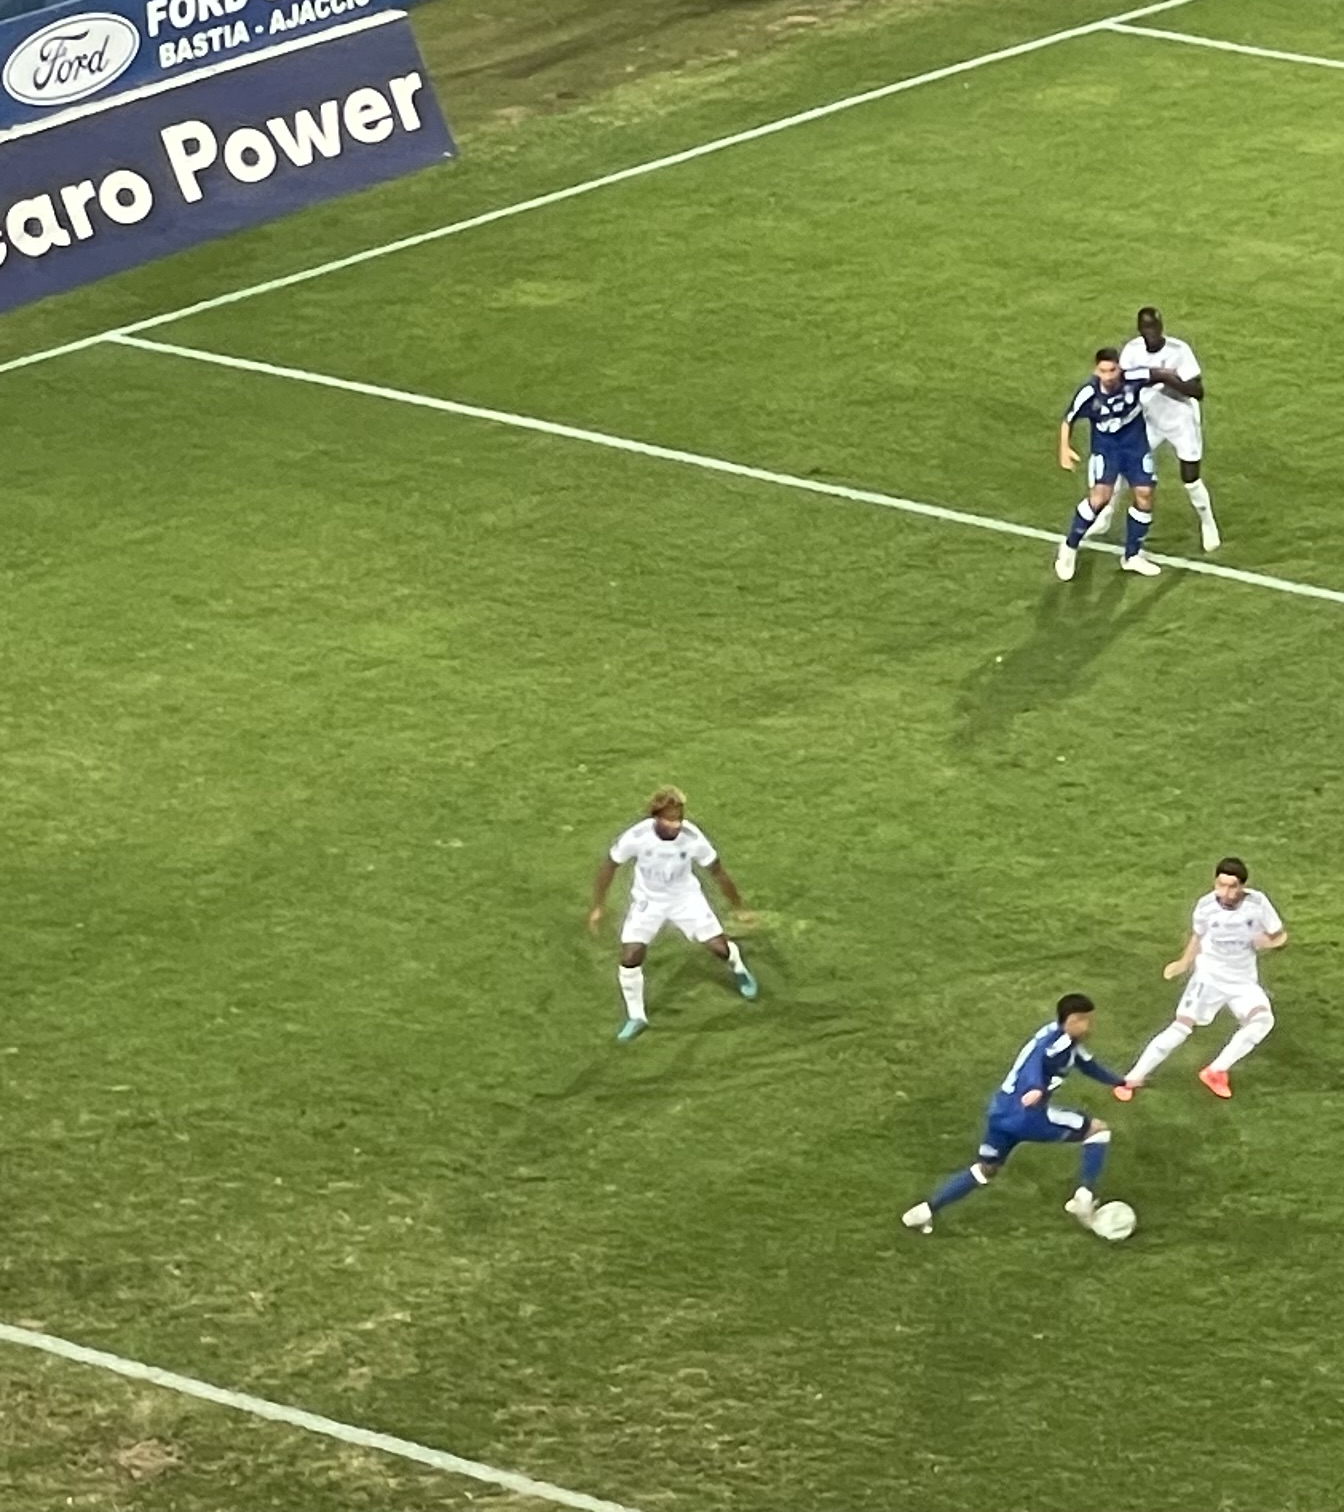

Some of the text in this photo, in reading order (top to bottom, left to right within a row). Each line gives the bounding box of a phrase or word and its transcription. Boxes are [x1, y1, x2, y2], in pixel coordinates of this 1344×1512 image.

[33, 28, 111, 91] Ford
[158, 21, 250, 69] BASTIA
[0, 71, 423, 268] aro Power
